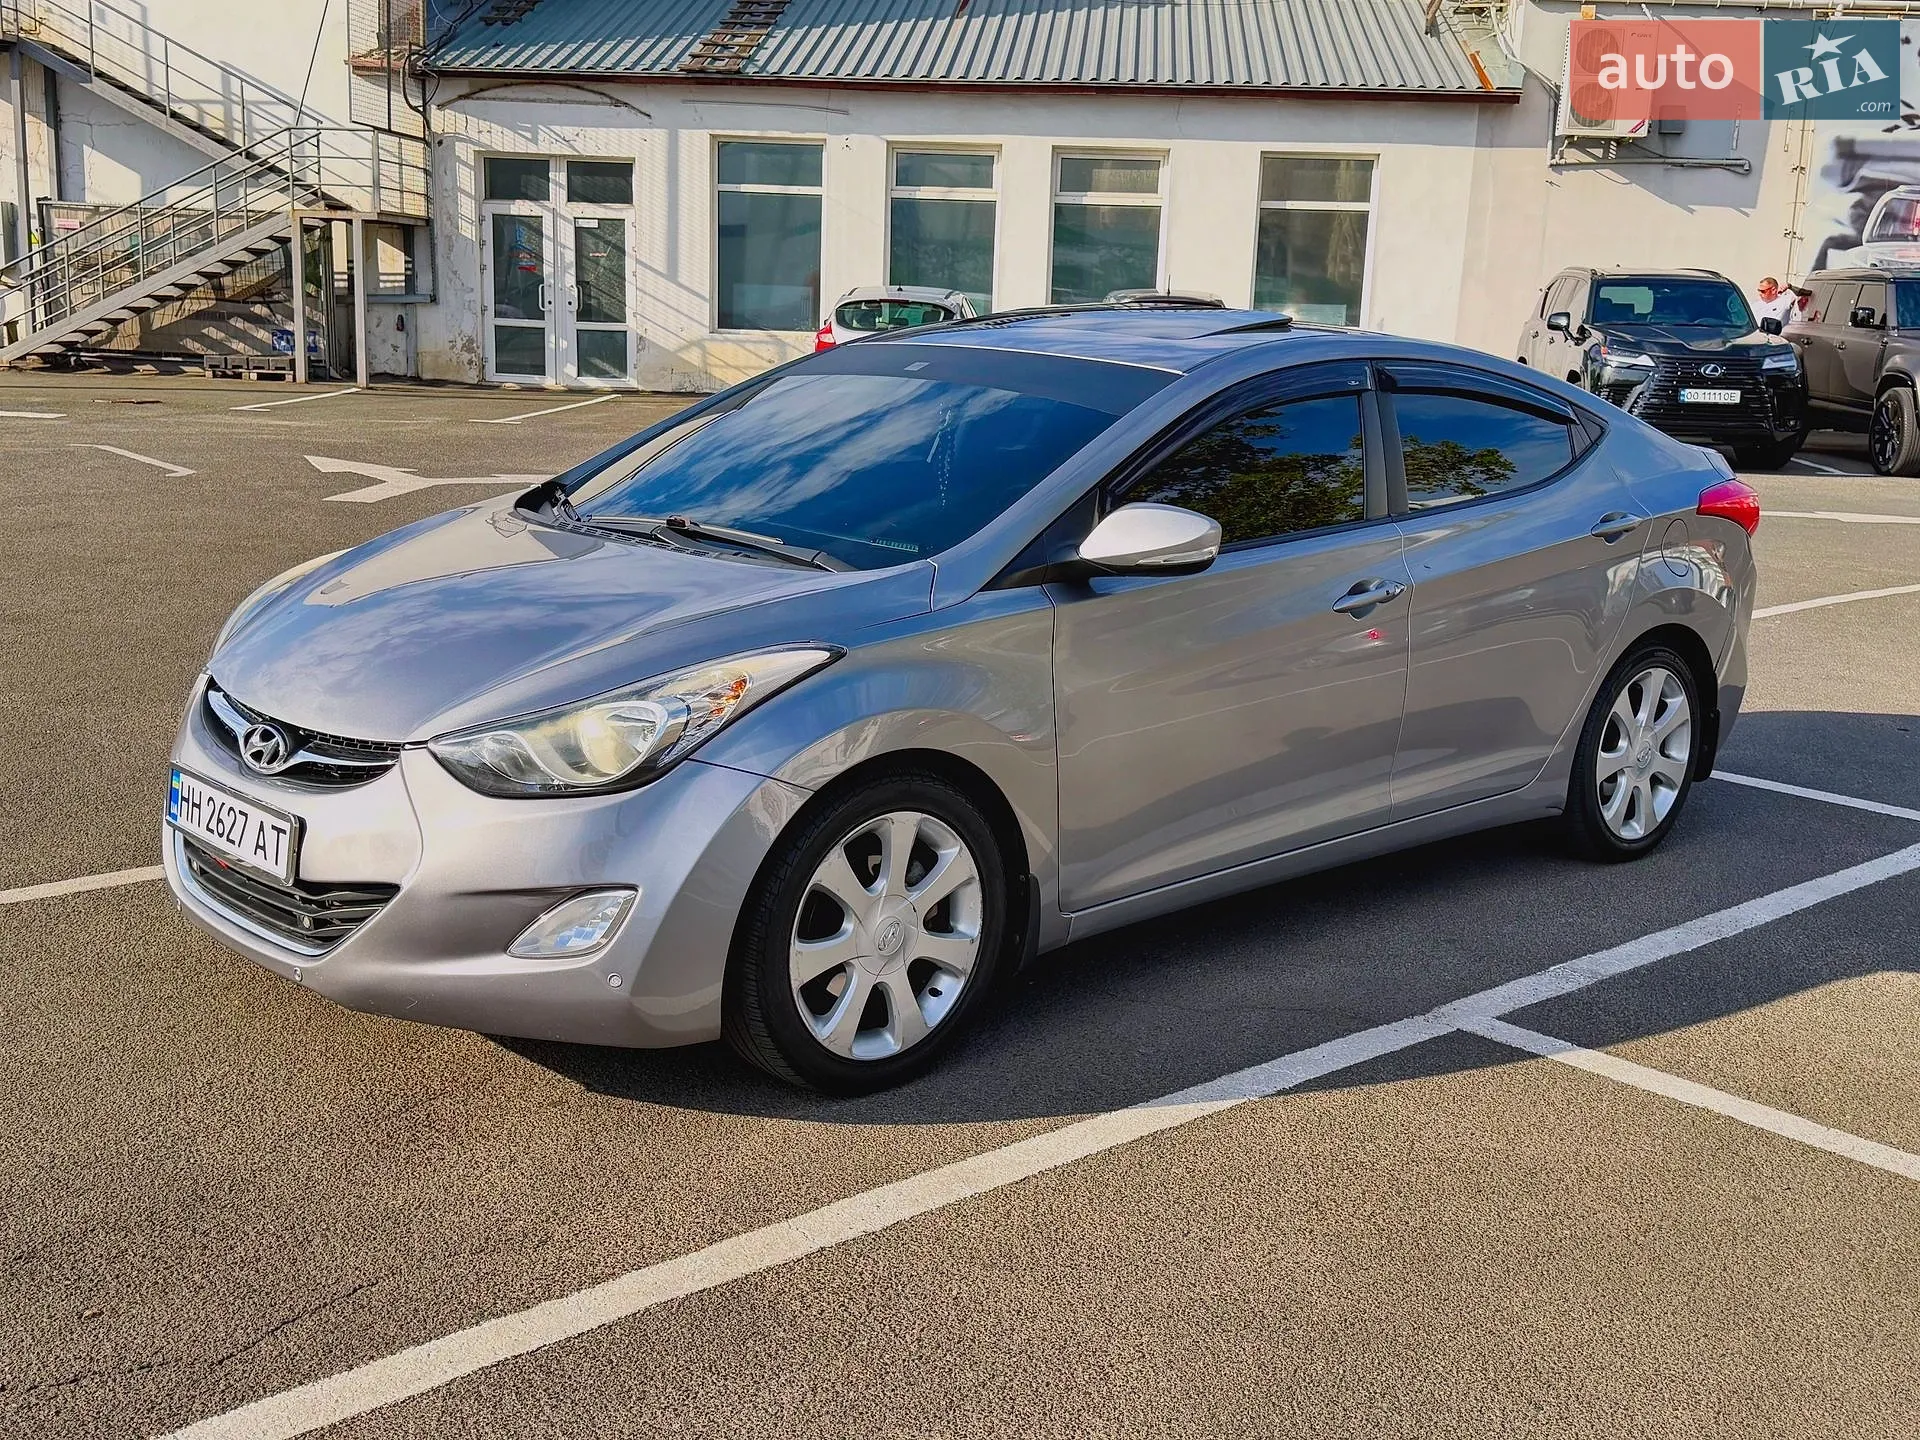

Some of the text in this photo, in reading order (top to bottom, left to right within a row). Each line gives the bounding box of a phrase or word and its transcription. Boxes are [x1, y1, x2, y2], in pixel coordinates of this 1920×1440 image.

[179, 781, 287, 866] HH 2627 AT
